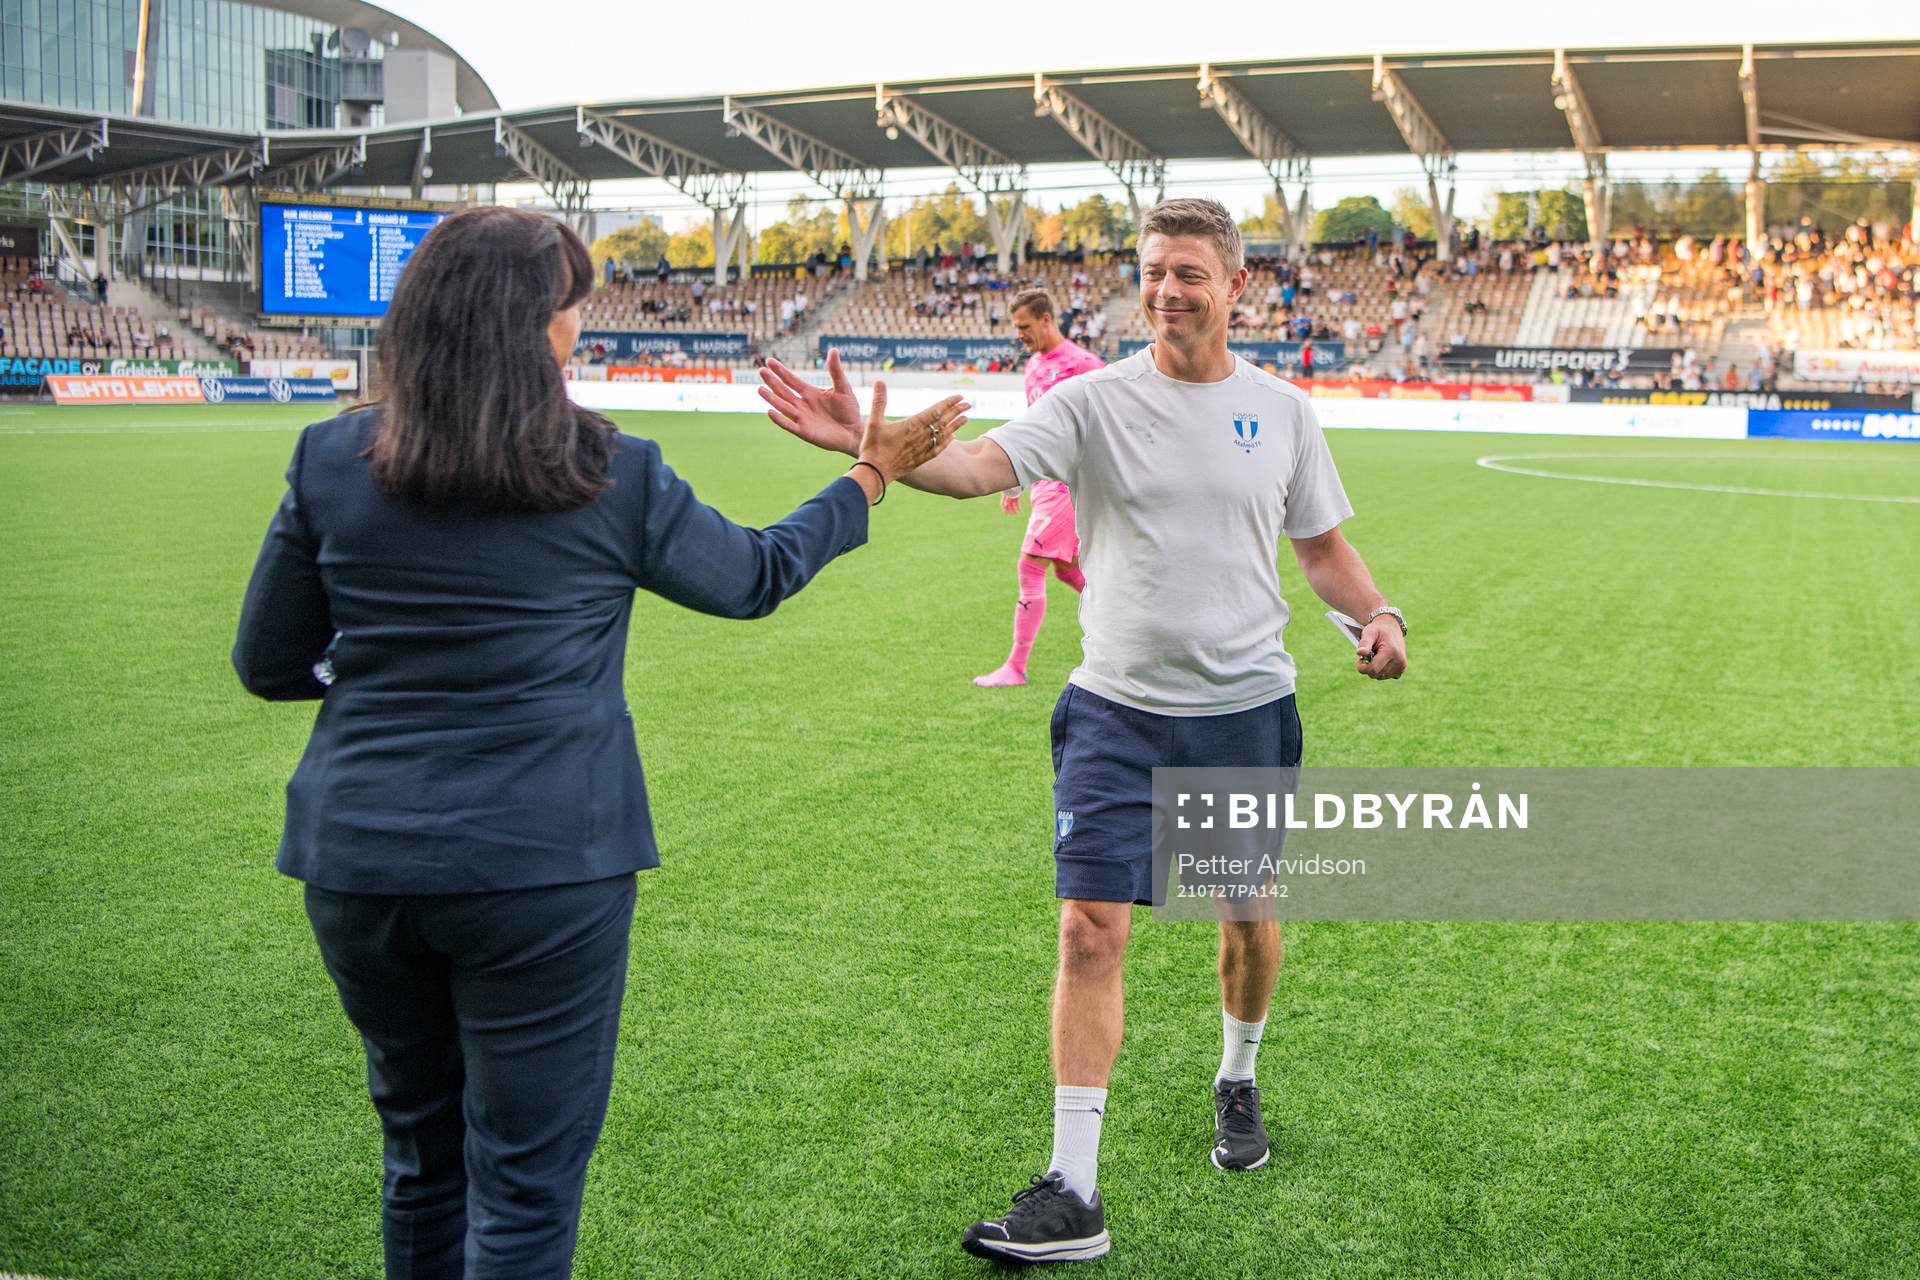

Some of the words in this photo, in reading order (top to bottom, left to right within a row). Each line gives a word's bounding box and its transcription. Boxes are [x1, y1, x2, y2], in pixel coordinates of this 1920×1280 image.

[0, 358, 81, 376] FACADE
[82, 362, 102, 376] OY
[52, 379, 129, 398] LEHTO
[129, 380, 201, 398] LEHTO
